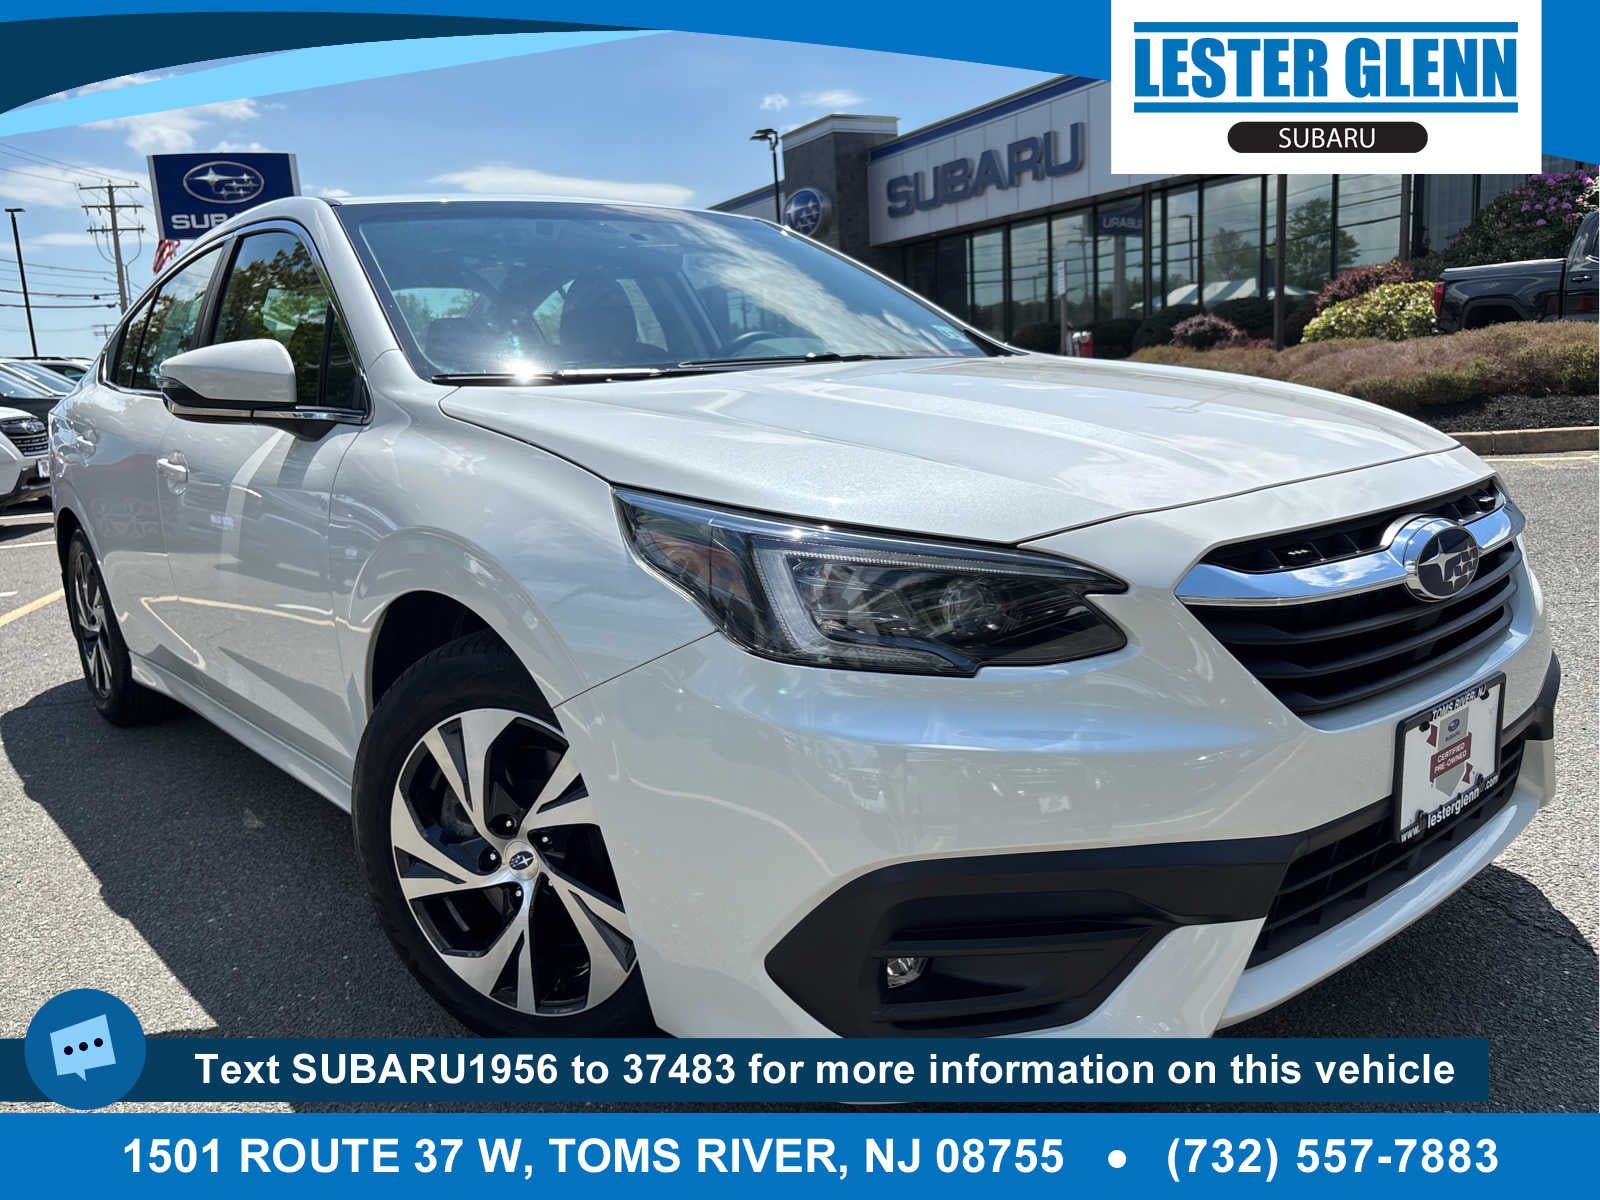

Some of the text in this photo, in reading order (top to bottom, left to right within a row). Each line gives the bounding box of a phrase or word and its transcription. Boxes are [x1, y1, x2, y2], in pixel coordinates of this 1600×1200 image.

[887, 122, 1085, 219] SUBARU
[171, 213, 238, 229] SUB
[1433, 702, 1454, 719] TOMS
[1434, 750, 1467, 774] PRE-OWNED
[1437, 742, 1465, 763] CERTIFIED
